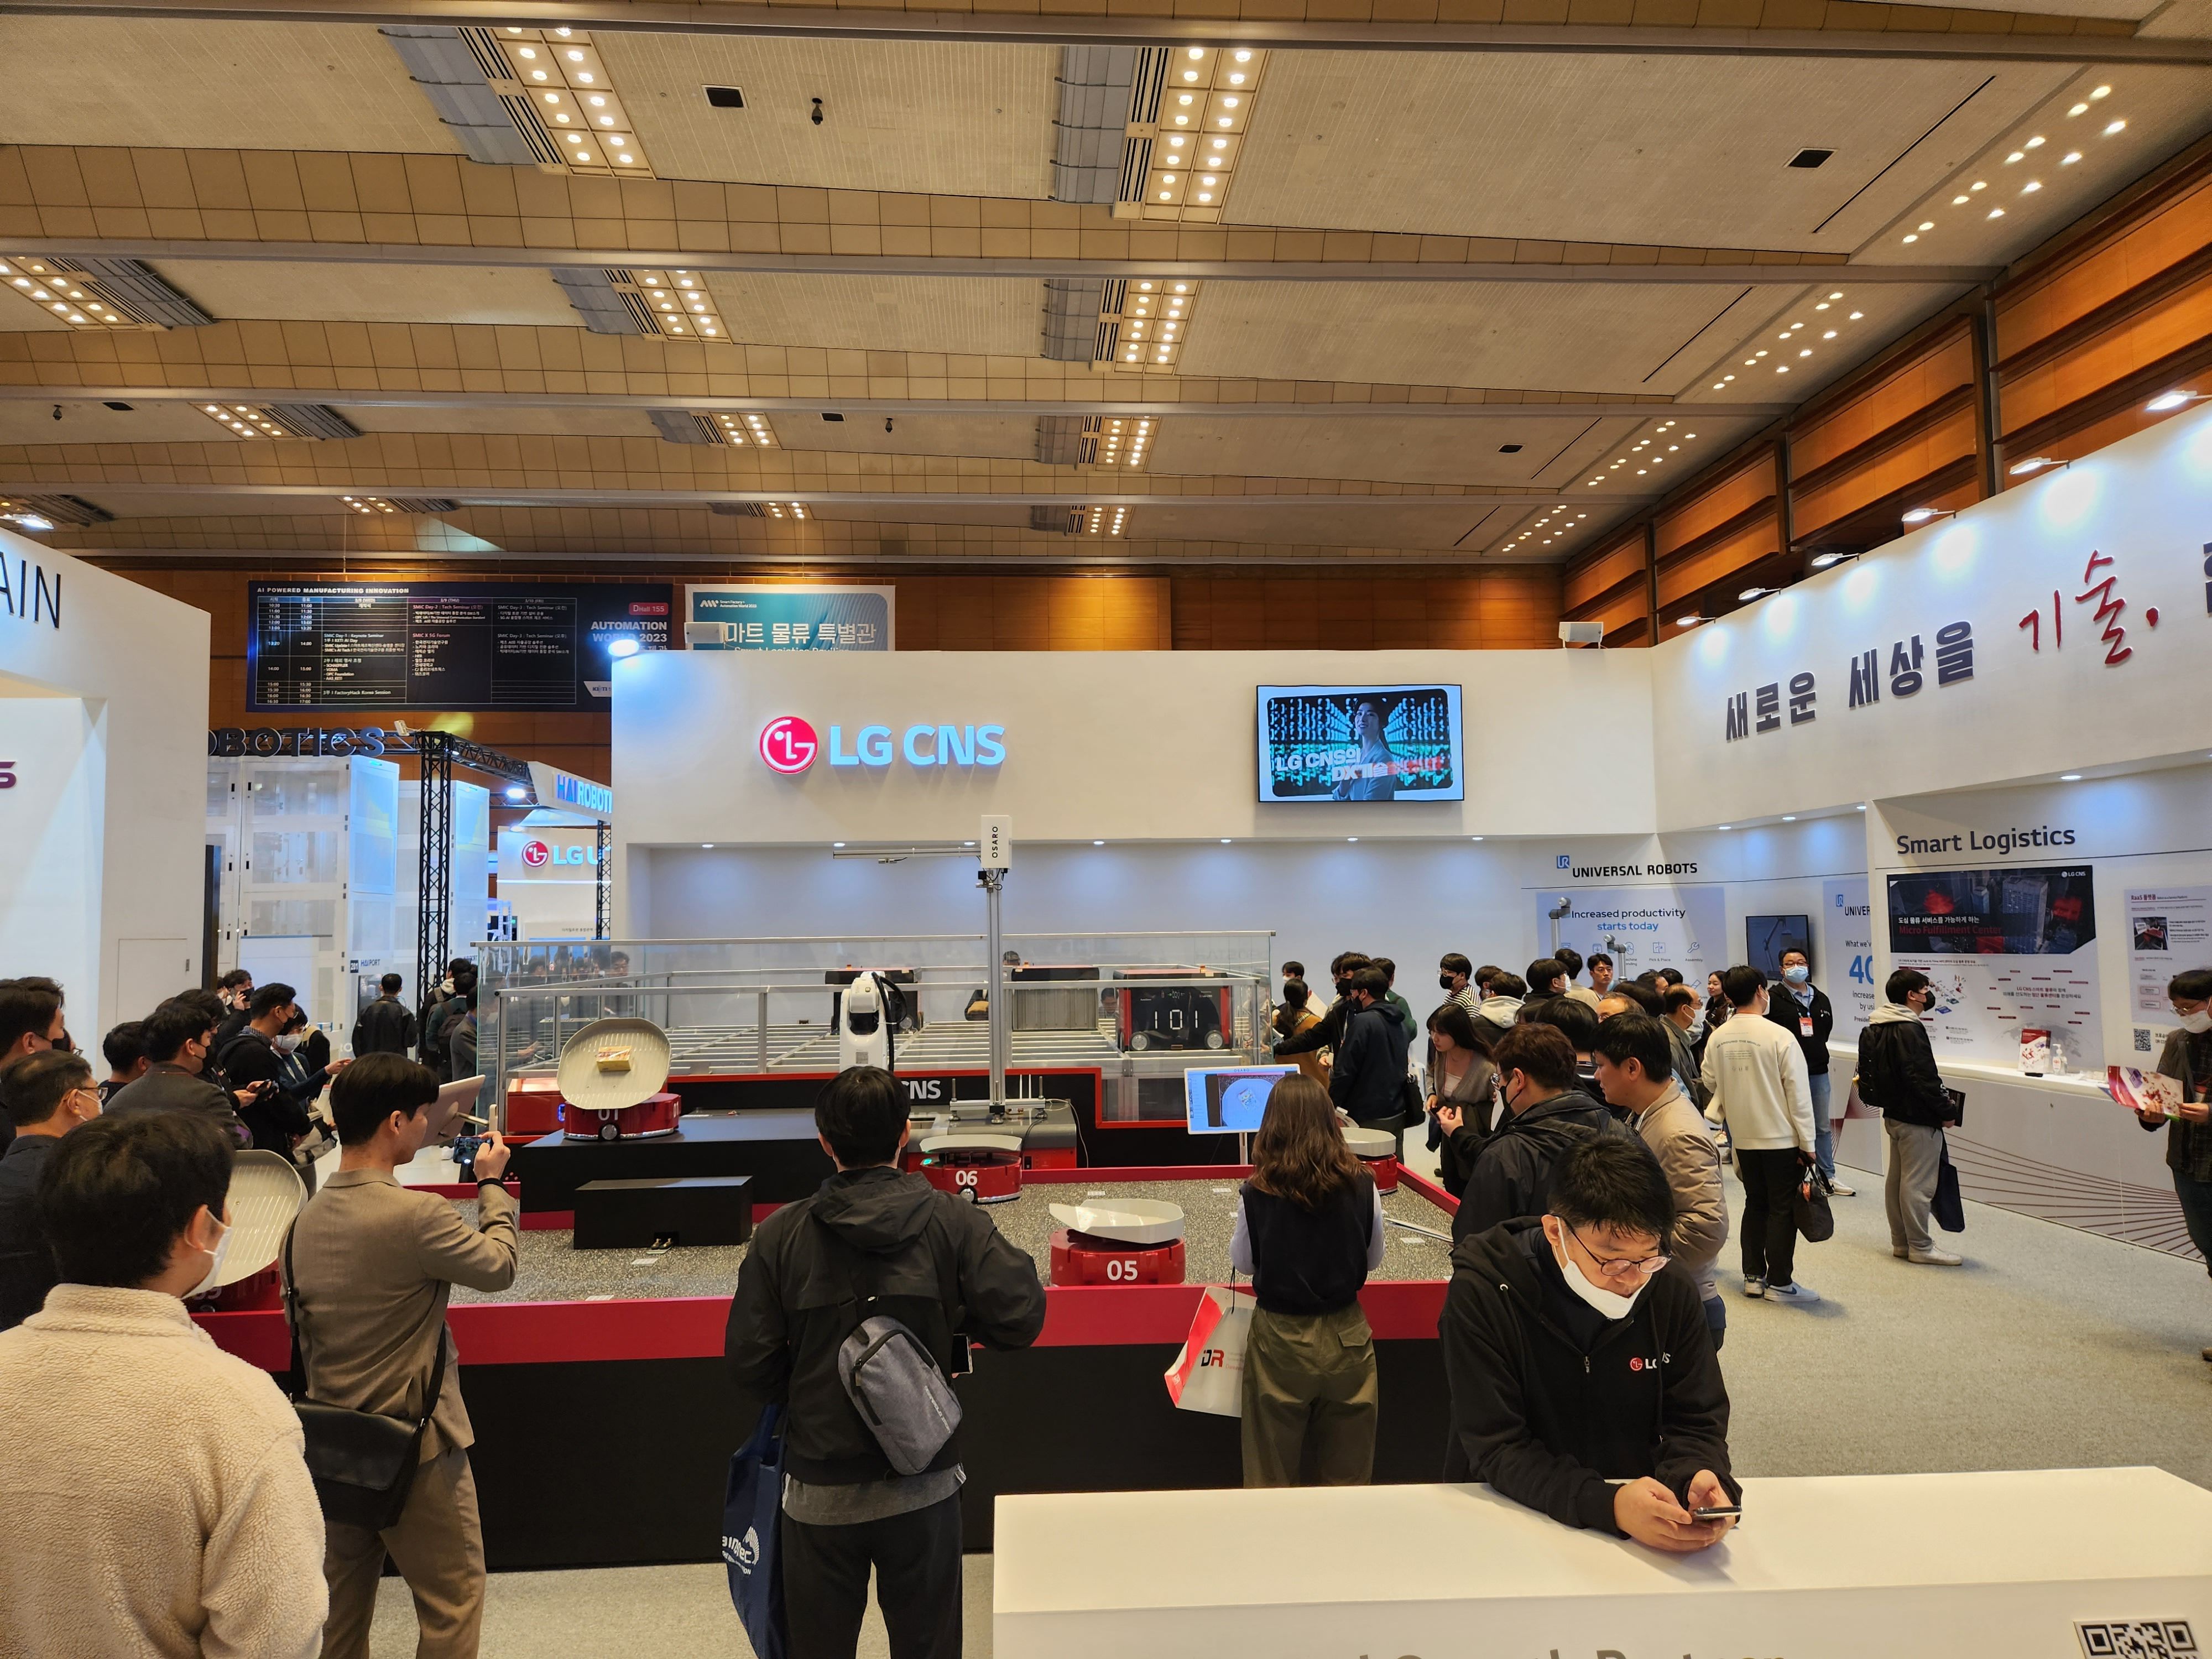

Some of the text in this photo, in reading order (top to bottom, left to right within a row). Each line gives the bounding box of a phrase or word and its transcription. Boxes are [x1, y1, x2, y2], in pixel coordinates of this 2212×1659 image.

[591, 622, 667, 630] AUTOMATION
[726, 623, 877, 644] 마트 물류 특별관
[639, 634, 667, 642] 2023
[1726, 671, 1816, 741] 새로운
[1849, 620, 1974, 708] 세상을
[830, 725, 1006, 766] LG CNS
[1276, 754, 1302, 771] LG
[1897, 826, 2075, 855] Smart Logistics
[553, 846, 583, 865] LG
[1572, 865, 1642, 878] UNIVERSAL
[1647, 863, 1698, 875] ROBOTS
[1572, 908, 1686, 919] Increased productivity
[1629, 921, 1658, 932] today
[1899, 925, 2001, 934] Micro Fulfillment Center
[1860, 1003, 1866, 1011] by
[901, 1080, 941, 1099] NS
[956, 1170, 978, 1186] 06
[1107, 1260, 1138, 1281] 05
